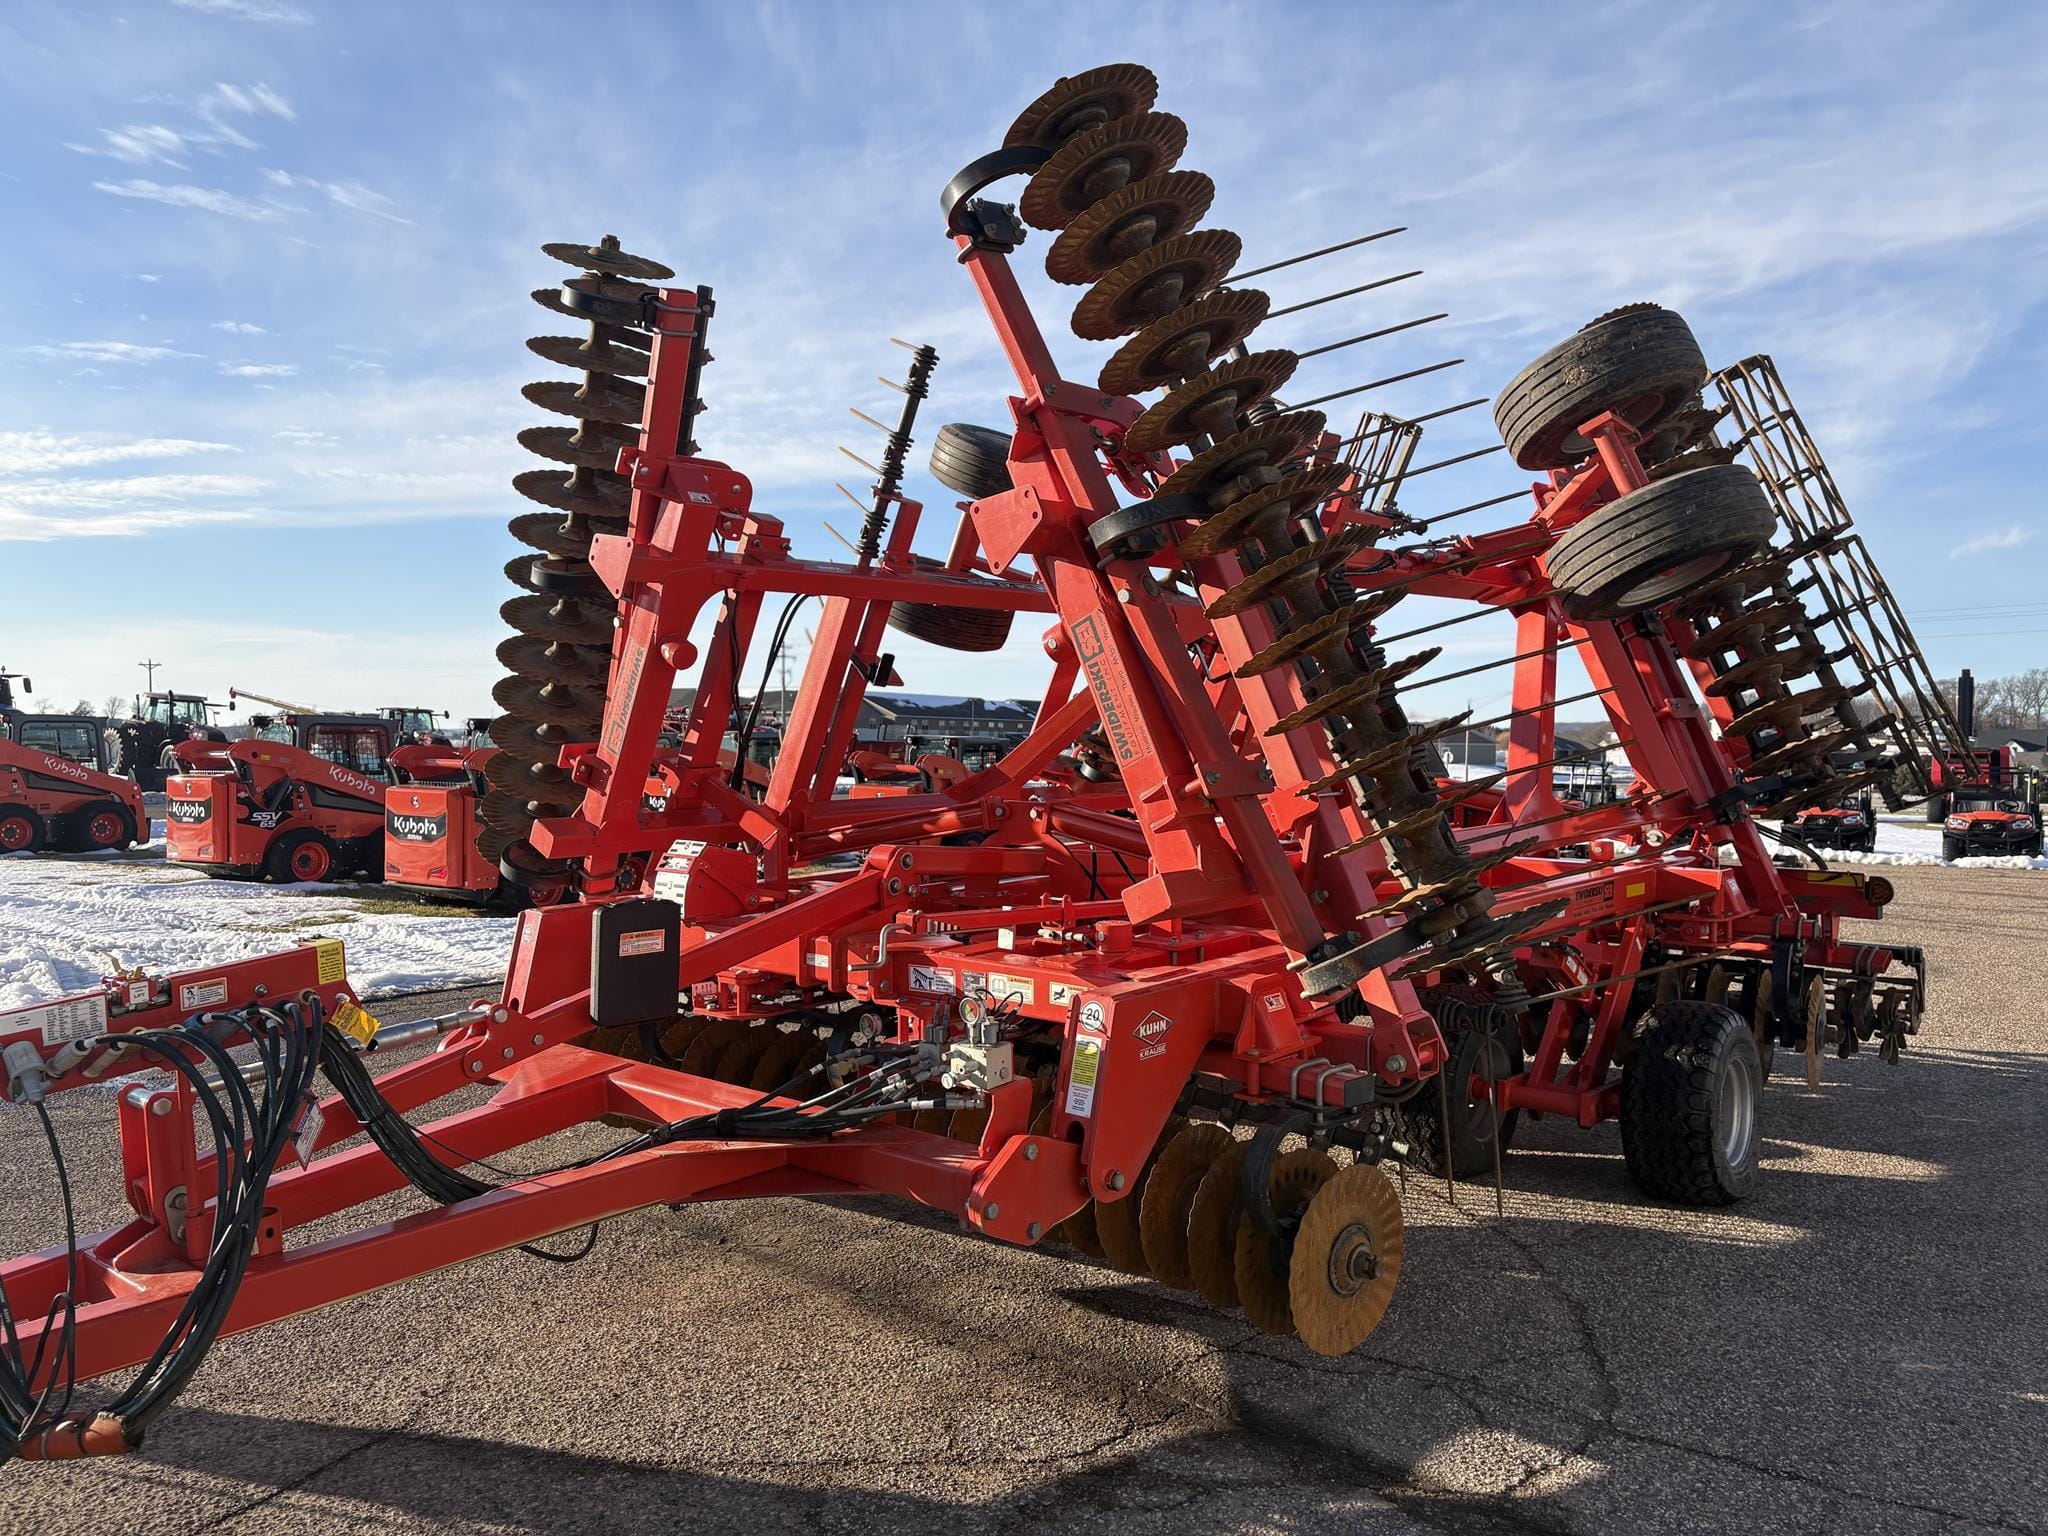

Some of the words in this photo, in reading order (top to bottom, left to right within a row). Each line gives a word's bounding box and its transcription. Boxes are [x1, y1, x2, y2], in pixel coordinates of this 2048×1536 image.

[1099, 659, 1112, 681] INC
[1119, 670, 1129, 690] Thorp
[620, 646, 645, 726] SWIDERSKI
[1087, 661, 1134, 761] SWIDERSKI
[1110, 687, 1141, 757] EQUIPMENT
[43, 756, 88, 781] Kubota
[329, 765, 376, 796] Kubota
[172, 801, 205, 817] Kubota
[649, 796, 666, 808] Kub
[250, 811, 282, 821] SSV
[259, 820, 276, 828] 65
[394, 815, 437, 835] Kubota
[1086, 1007, 1100, 1022] 20
[1139, 1019, 1167, 1038] KUHN
[1139, 1044, 1167, 1059] KRAUSE
